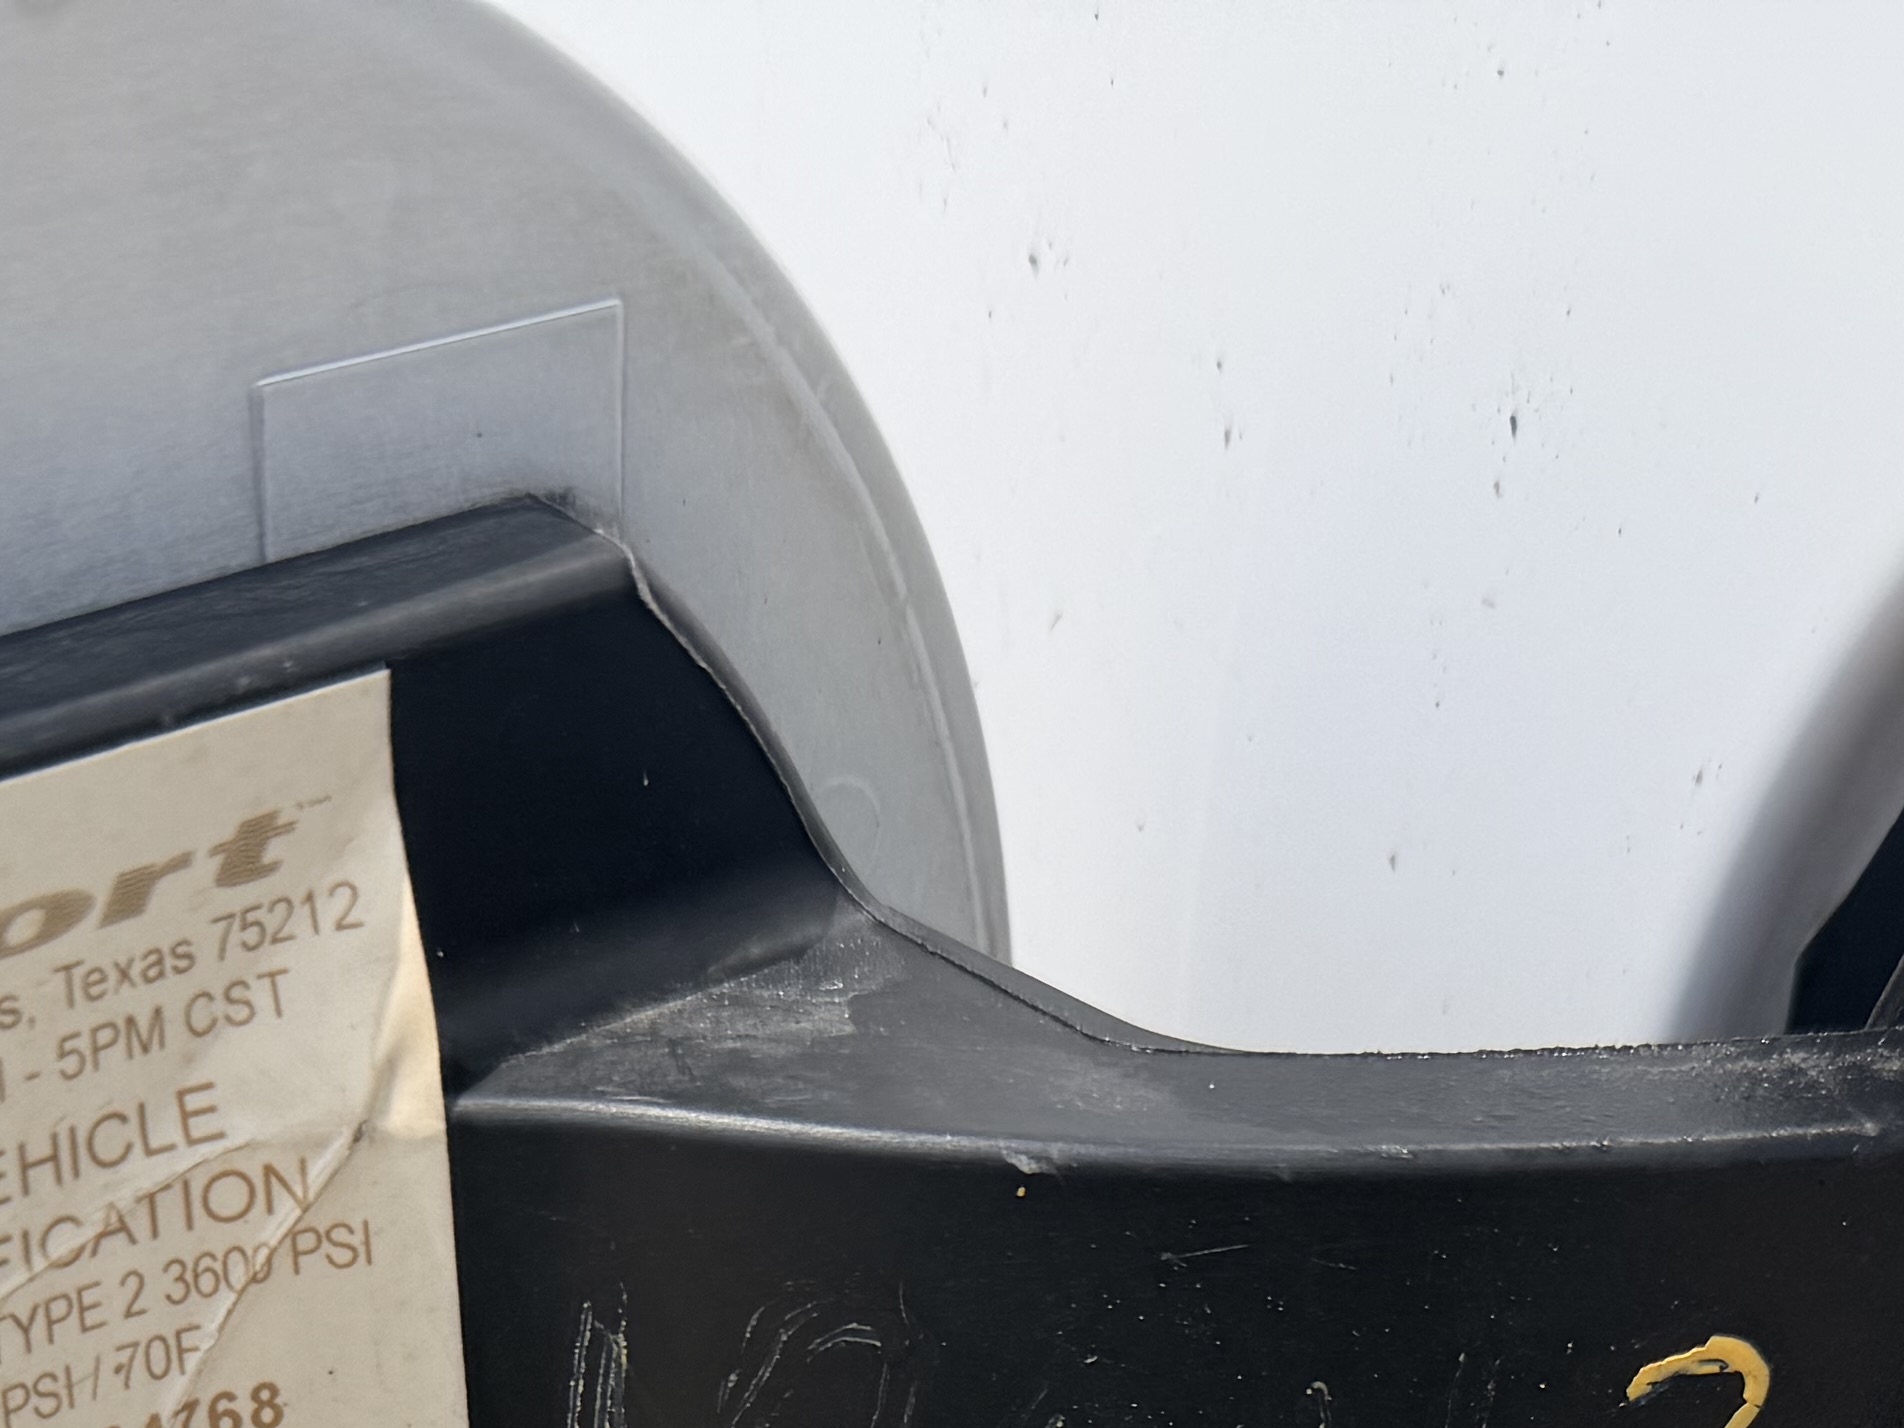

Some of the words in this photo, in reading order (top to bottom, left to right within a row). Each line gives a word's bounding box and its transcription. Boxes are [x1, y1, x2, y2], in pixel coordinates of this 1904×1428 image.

[52, 936, 196, 1009] Texas
[209, 880, 365, 962] 75212
[56, 1007, 167, 1080] 5PM
[184, 969, 290, 1039] CST
[119, 1268, 147, 1321] 2
[162, 1243, 273, 1306] 3600
[289, 1219, 374, 1277] PSI
